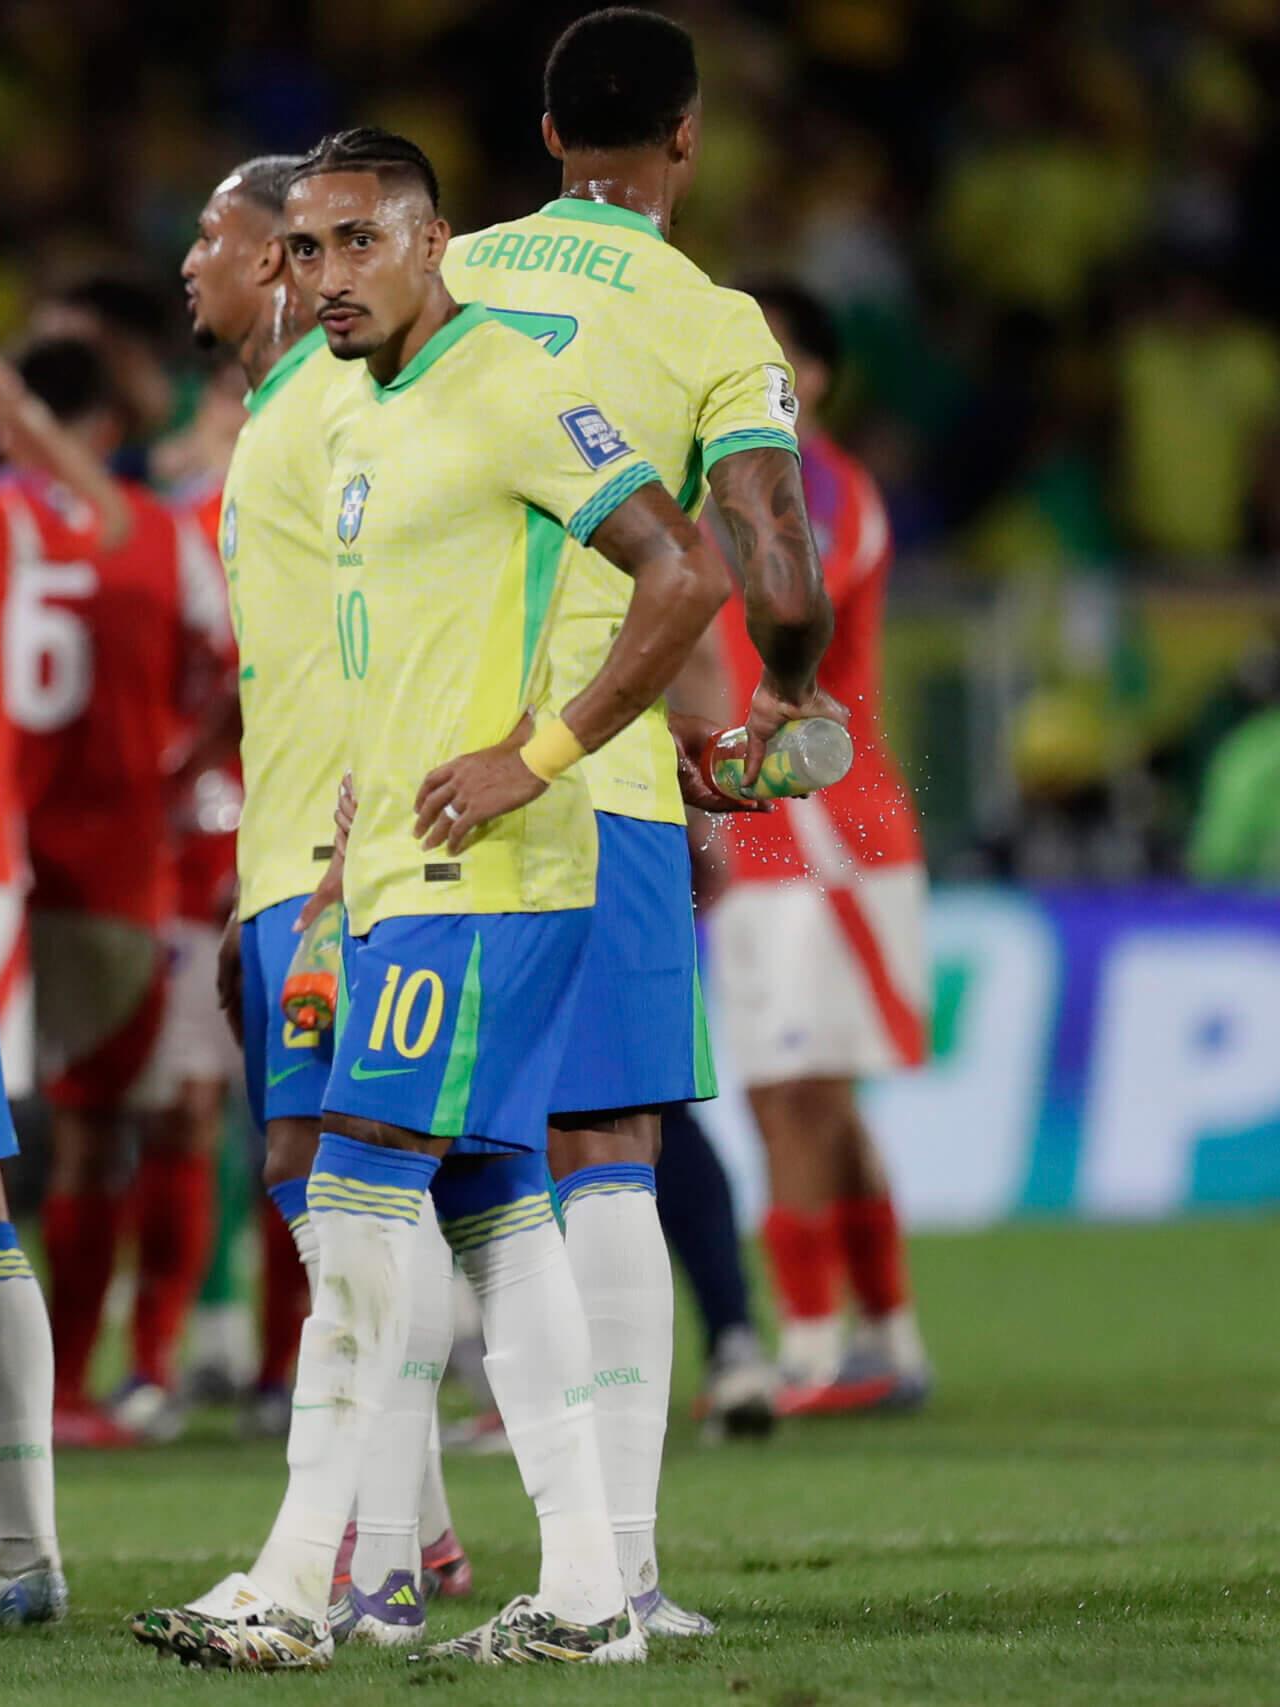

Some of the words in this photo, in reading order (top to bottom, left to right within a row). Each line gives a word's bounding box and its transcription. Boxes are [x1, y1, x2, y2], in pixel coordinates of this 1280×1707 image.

[465, 233, 636, 293] GABRIEL
[336, 590, 368, 681] 10
[368, 964, 446, 1060] 10
